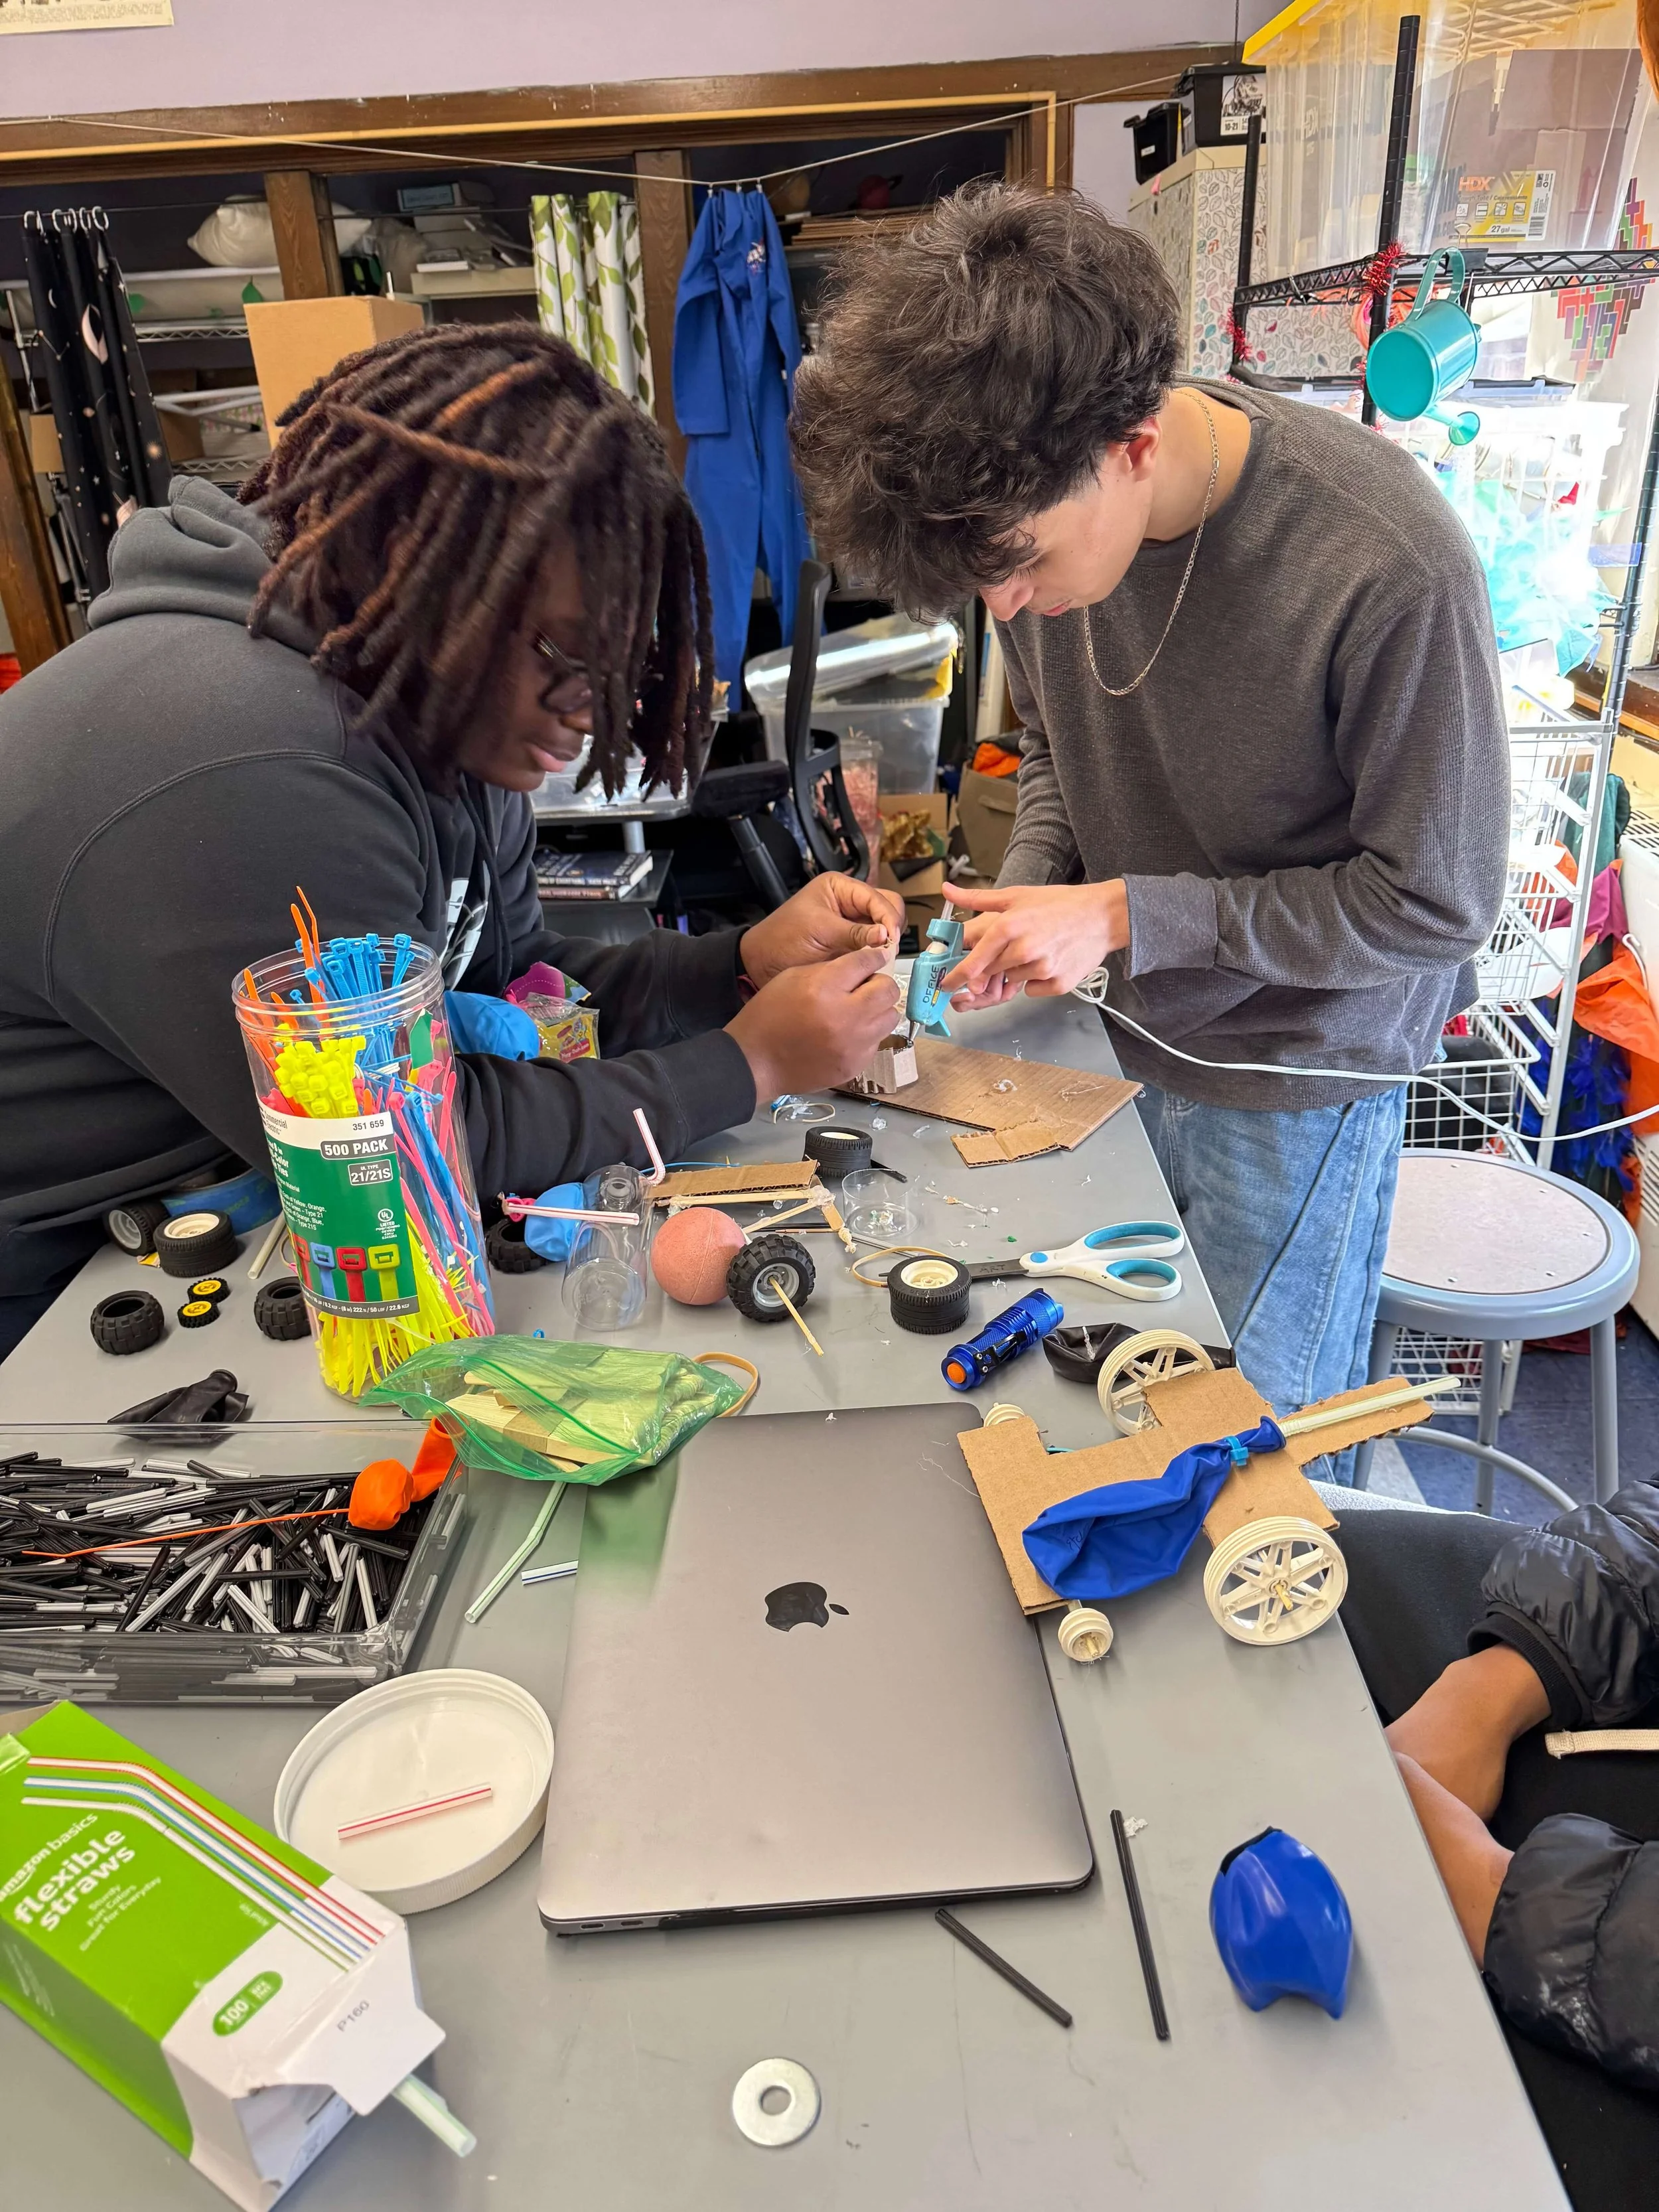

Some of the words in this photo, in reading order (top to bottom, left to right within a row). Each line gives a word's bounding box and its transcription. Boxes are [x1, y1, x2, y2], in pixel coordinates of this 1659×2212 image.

[1458, 176, 1492, 192] HDX
[922, 965, 940, 1003] OFFICE
[264, 1110, 288, 1130] Commercial
[352, 1122, 367, 1131] 351
[370, 1119, 385, 1129] 659
[324, 1143, 350, 1157] 500
[352, 1138, 389, 1155] PACK
[277, 1163, 289, 1177] Ties
[350, 1167, 392, 1183] 21/21S
[305, 1209, 317, 1218] Type
[312, 1217, 325, 1226] Blue,
[297, 1218, 308, 1228] Type
[979, 1264, 1006, 1274] ART
[46, 1812, 98, 1851] basics
[13, 1830, 126, 1925] flexible
[40, 1846, 136, 1933] straws
[218, 1998, 250, 2026] 100
[336, 2000, 371, 2033] P160
